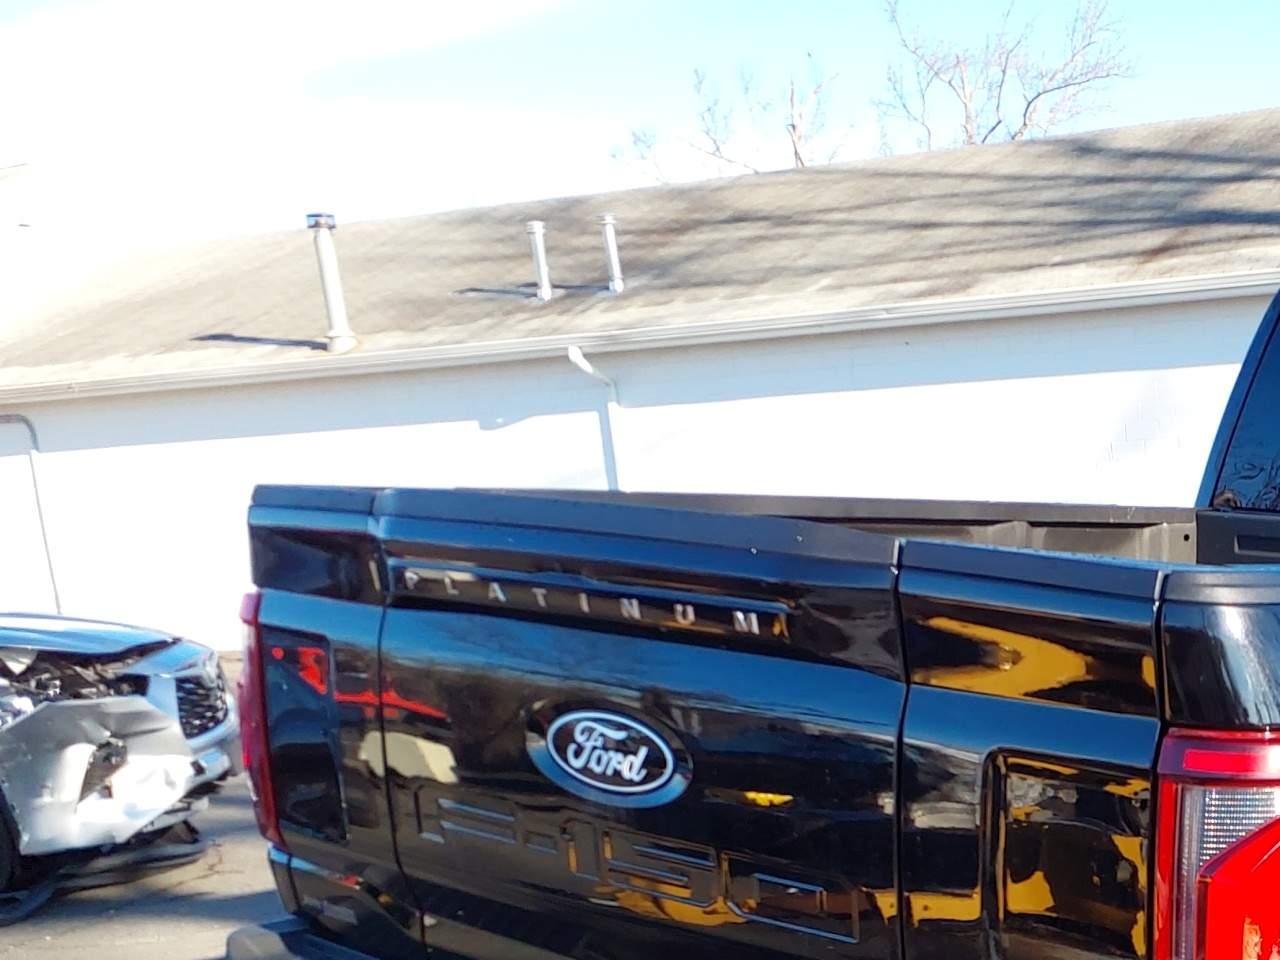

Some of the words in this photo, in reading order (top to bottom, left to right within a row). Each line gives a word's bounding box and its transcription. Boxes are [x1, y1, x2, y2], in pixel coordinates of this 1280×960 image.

[402, 570, 760, 636] PLATINUM
[566, 720, 649, 784] Ford
[412, 784, 862, 944] F-150
